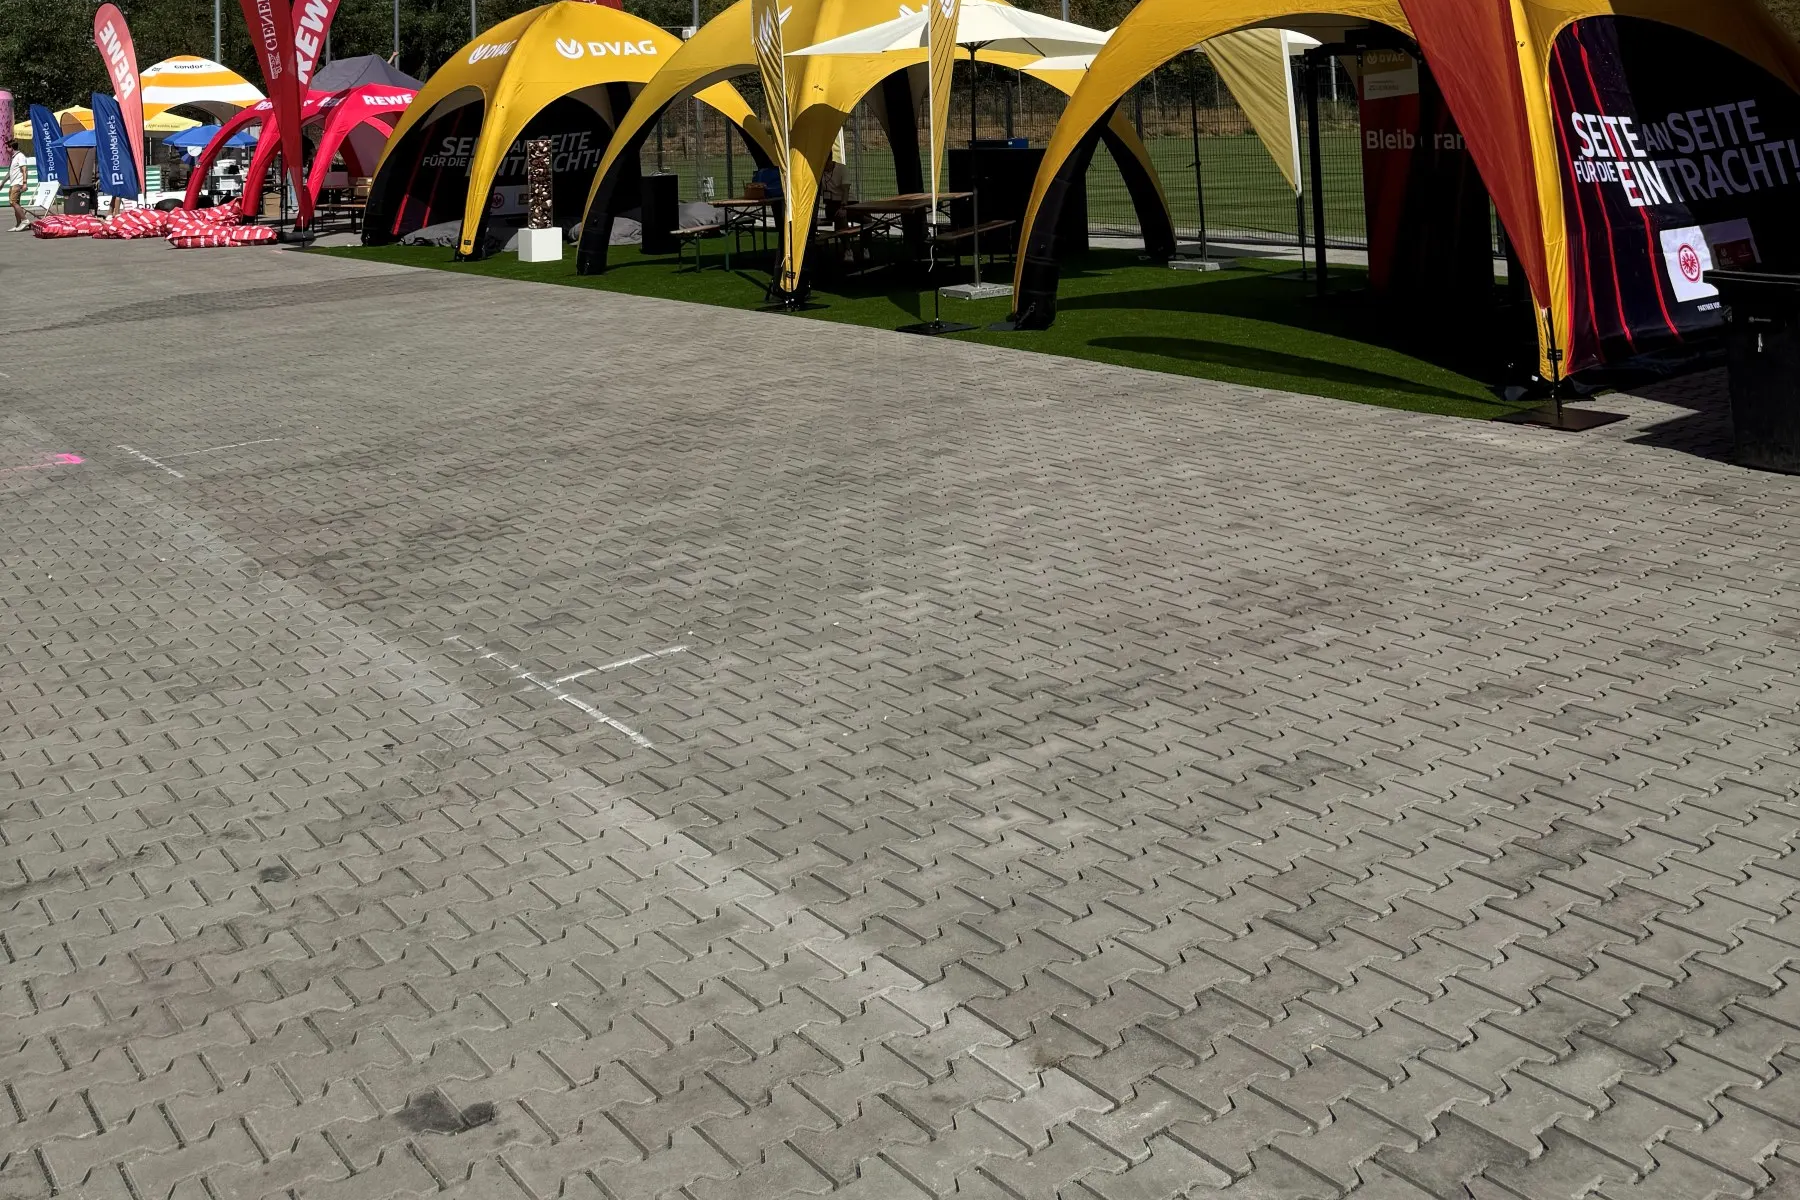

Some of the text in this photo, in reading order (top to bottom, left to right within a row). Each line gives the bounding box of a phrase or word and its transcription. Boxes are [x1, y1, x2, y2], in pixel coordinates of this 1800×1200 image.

[587, 40, 658, 57] DVAG
[361, 94, 413, 106] REWE
[1365, 128, 1416, 150] Bleib
[1571, 99, 1766, 158] SEITE AN SEITE
[1573, 155, 1598, 183] FÜR
[1597, 161, 1619, 183] DIE
